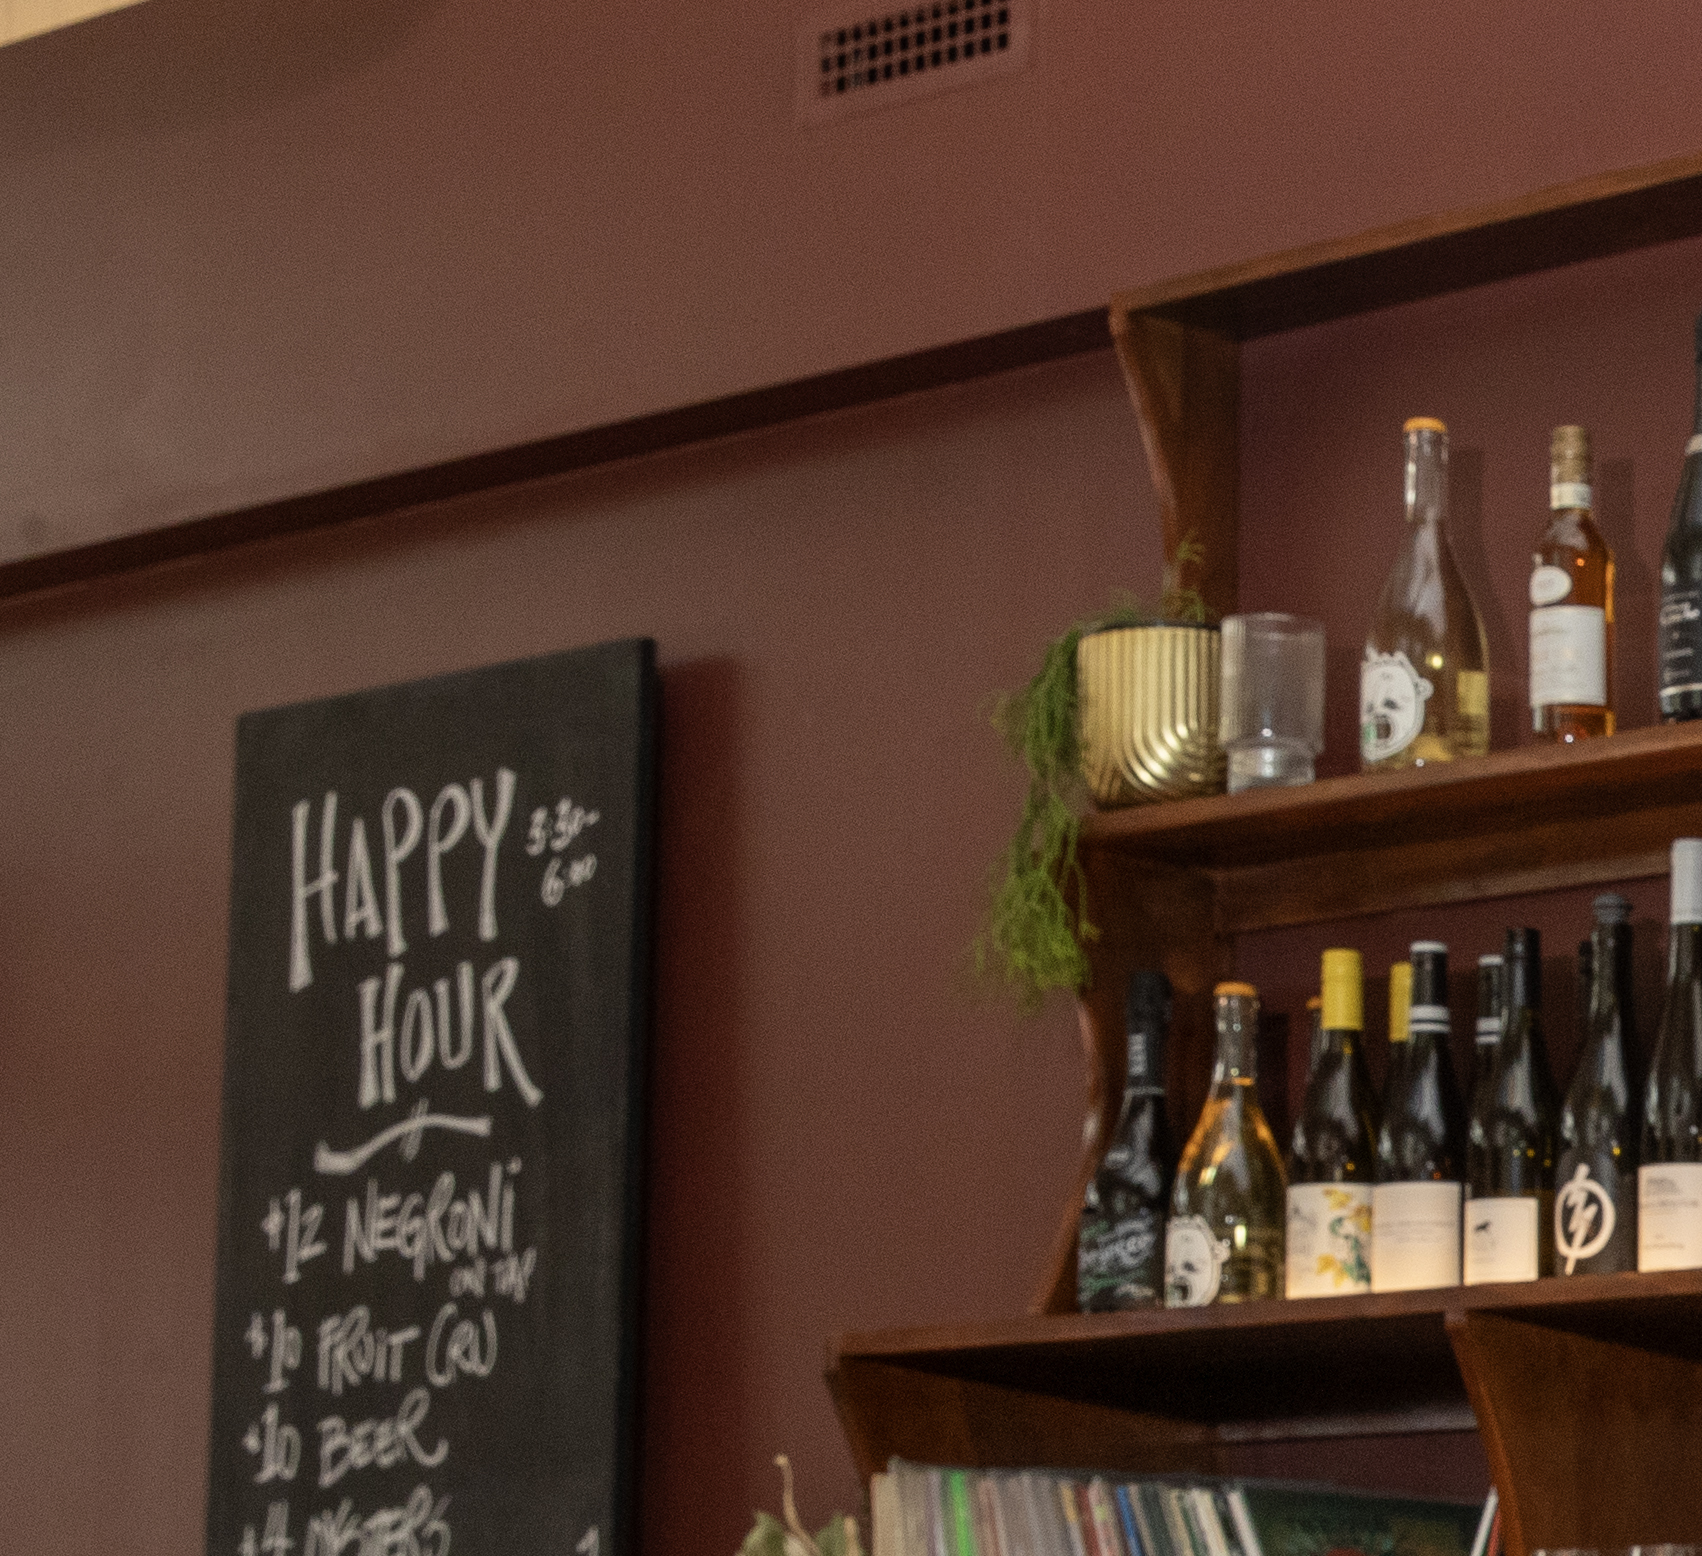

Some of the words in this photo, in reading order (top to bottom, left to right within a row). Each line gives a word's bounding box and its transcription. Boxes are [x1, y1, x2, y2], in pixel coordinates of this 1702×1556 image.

[289, 767, 516, 993] HAPPY
[358, 956, 544, 1111] HOUR
[261, 1188, 327, 1284] $12
[244, 1308, 301, 1393] $10
[426, 1302, 497, 1388] CRU
[241, 1402, 299, 1484] $10
[317, 1388, 449, 1488] BEER
